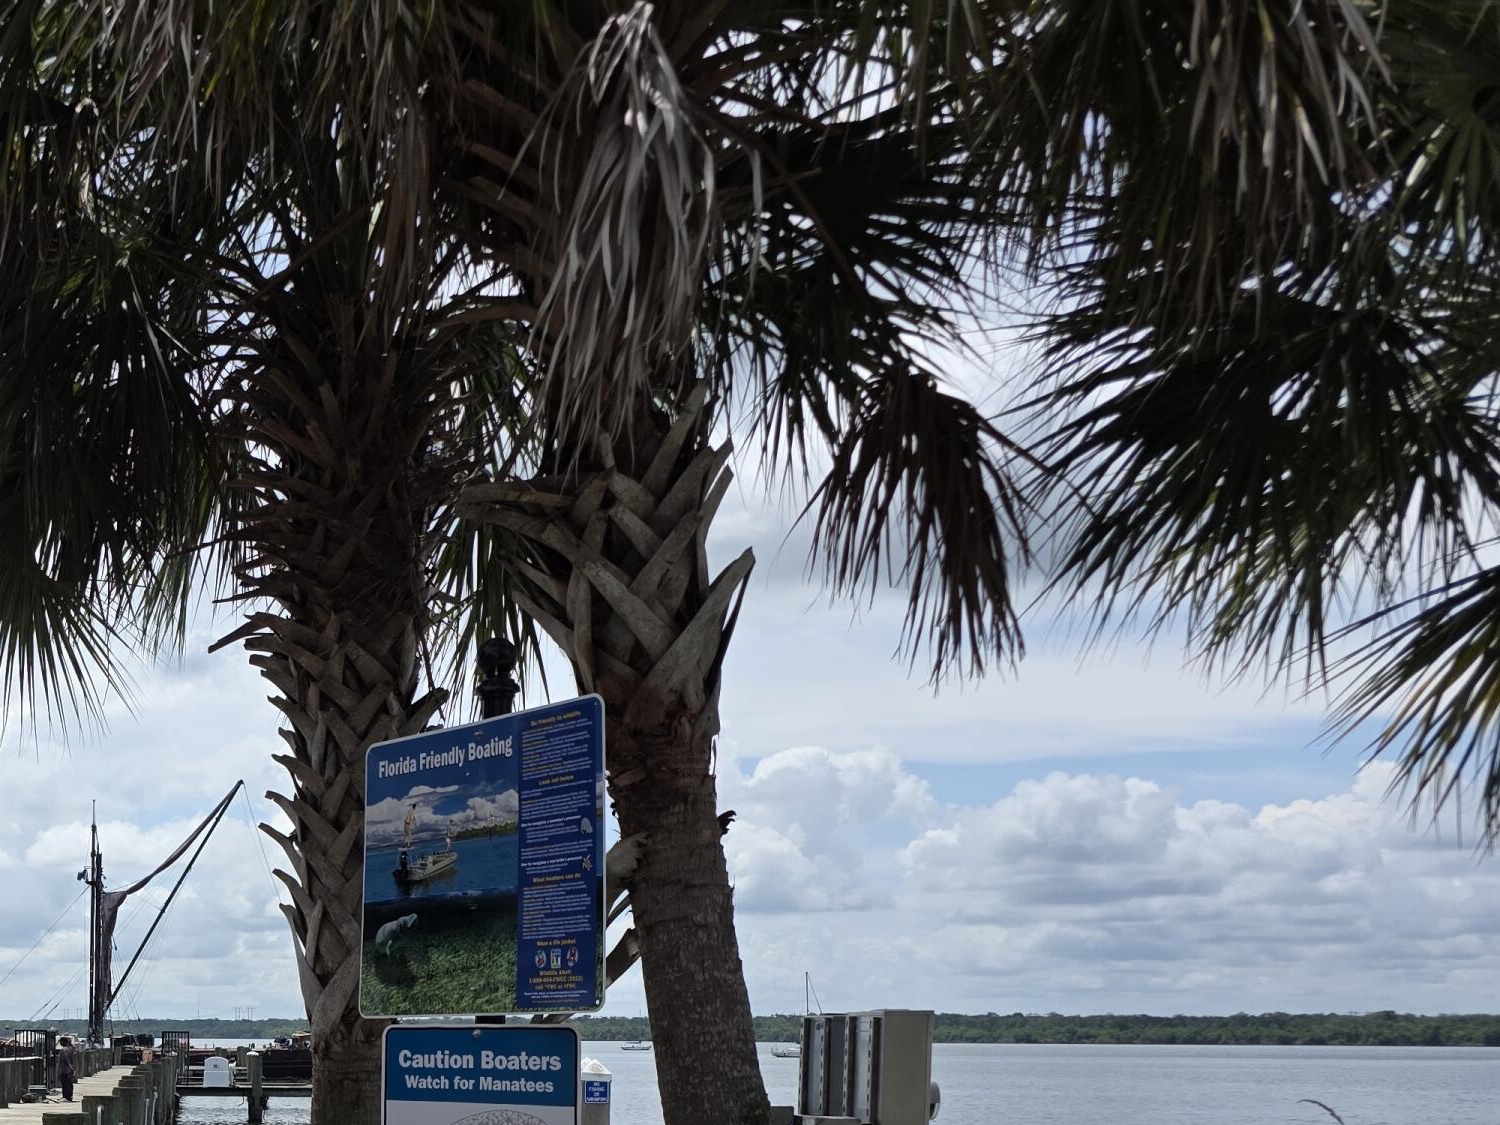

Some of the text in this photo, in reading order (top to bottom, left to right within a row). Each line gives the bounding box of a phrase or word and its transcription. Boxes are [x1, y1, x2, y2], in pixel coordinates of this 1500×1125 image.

[379, 756, 417, 778] Florida
[420, 746, 466, 771] Friendly
[468, 736, 513, 761] Boating
[398, 1049, 562, 1071] Caution Boaters
[404, 1074, 554, 1093] Watch for Manatees
